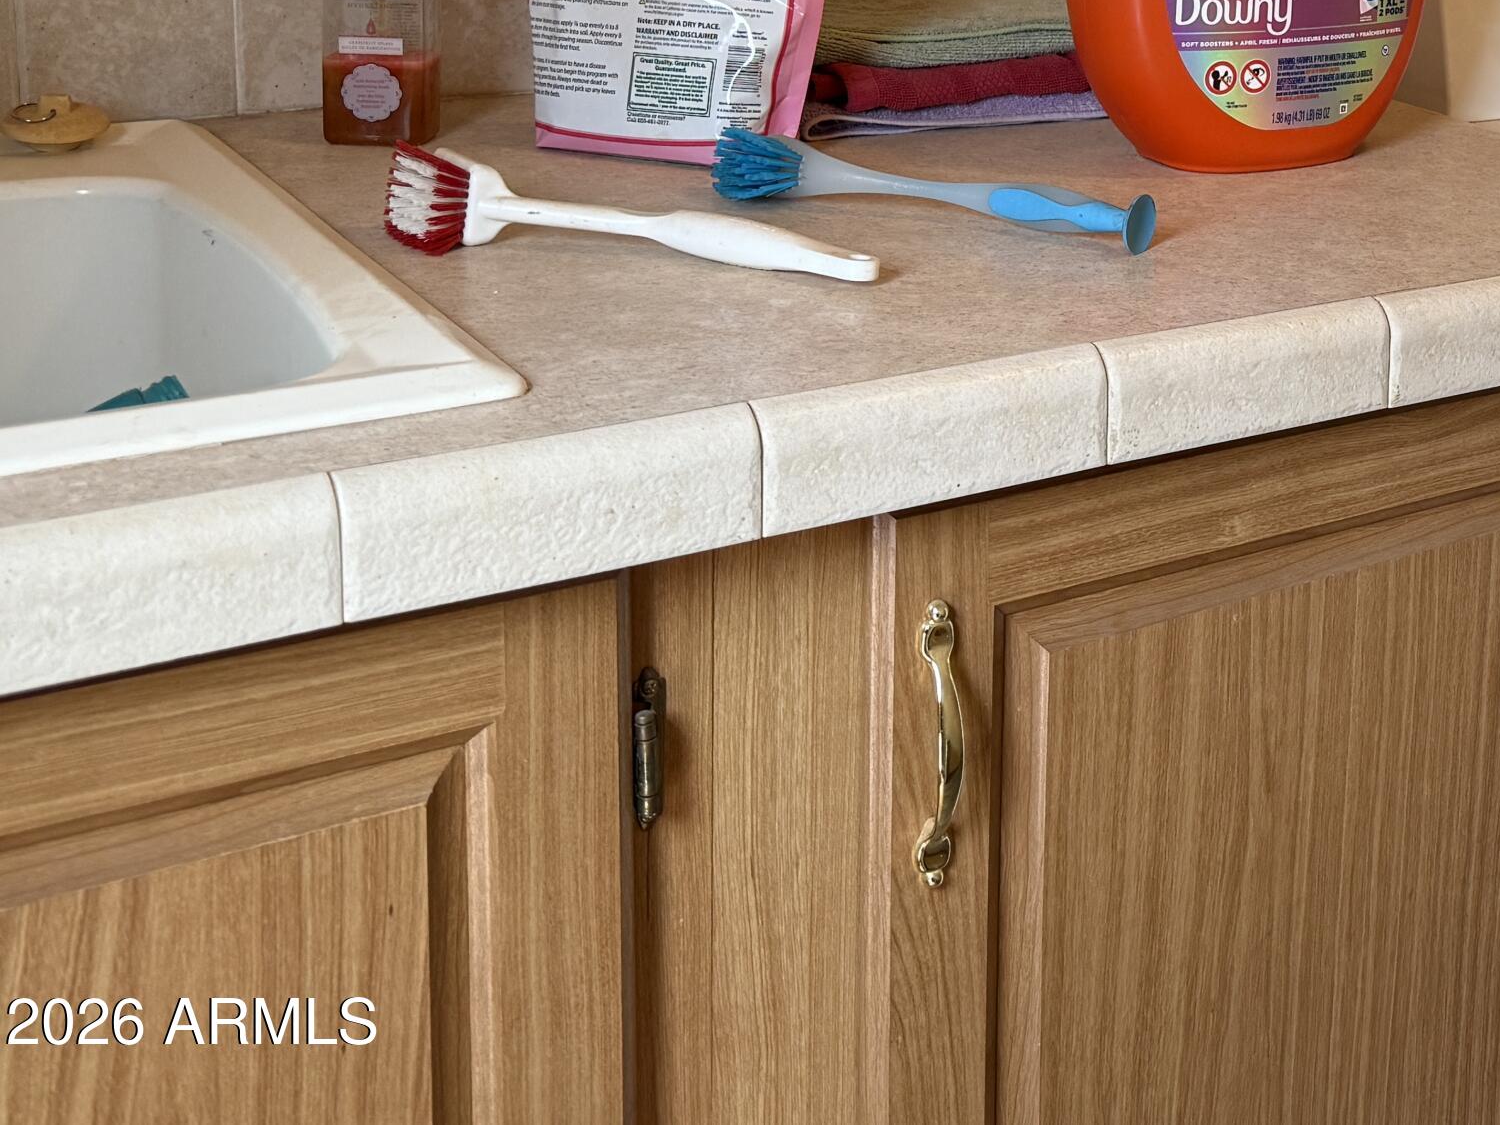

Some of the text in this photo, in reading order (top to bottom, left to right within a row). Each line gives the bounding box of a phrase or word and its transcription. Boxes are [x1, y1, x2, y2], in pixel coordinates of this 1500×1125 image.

[1379, 9, 1384, 17] 2
[653, 18, 668, 26] KEEP
[682, 20, 697, 28] DRY
[697, 21, 720, 30] PLACE.
[636, 27, 718, 40] WARRANTY AND DISCLAIMER
[1272, 111, 1284, 124] 1.98
[1284, 111, 1292, 125] kg
[1292, 110, 1305, 124] (4.31
[1306, 108, 1315, 122] LB)
[1323, 107, 1331, 119] OZ
